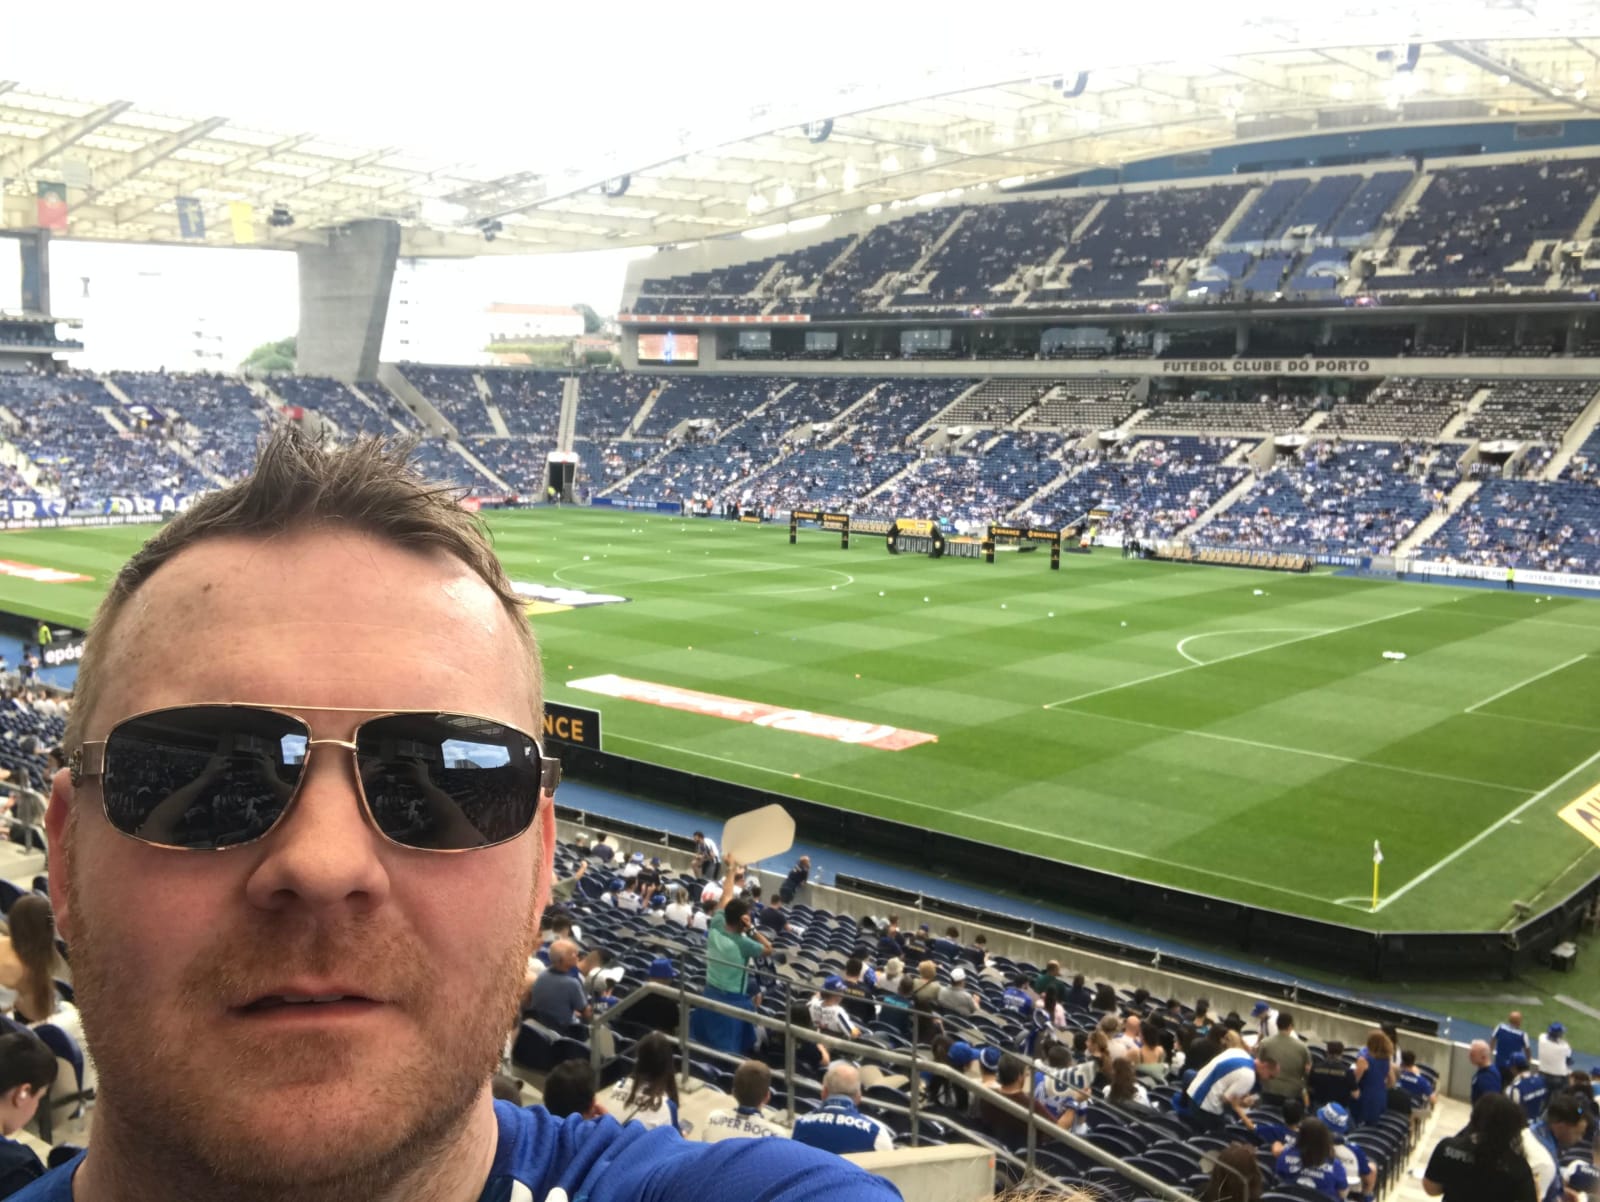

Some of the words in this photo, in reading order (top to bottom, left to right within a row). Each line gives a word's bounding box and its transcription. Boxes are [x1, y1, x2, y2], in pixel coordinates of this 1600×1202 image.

[1163, 361, 1228, 373] FUTEBOL
[1233, 361, 1281, 372] CLUBE
[1287, 361, 1310, 372] DO
[1315, 361, 1370, 372] PORTO
[836, 1114, 872, 1133] BOCK
